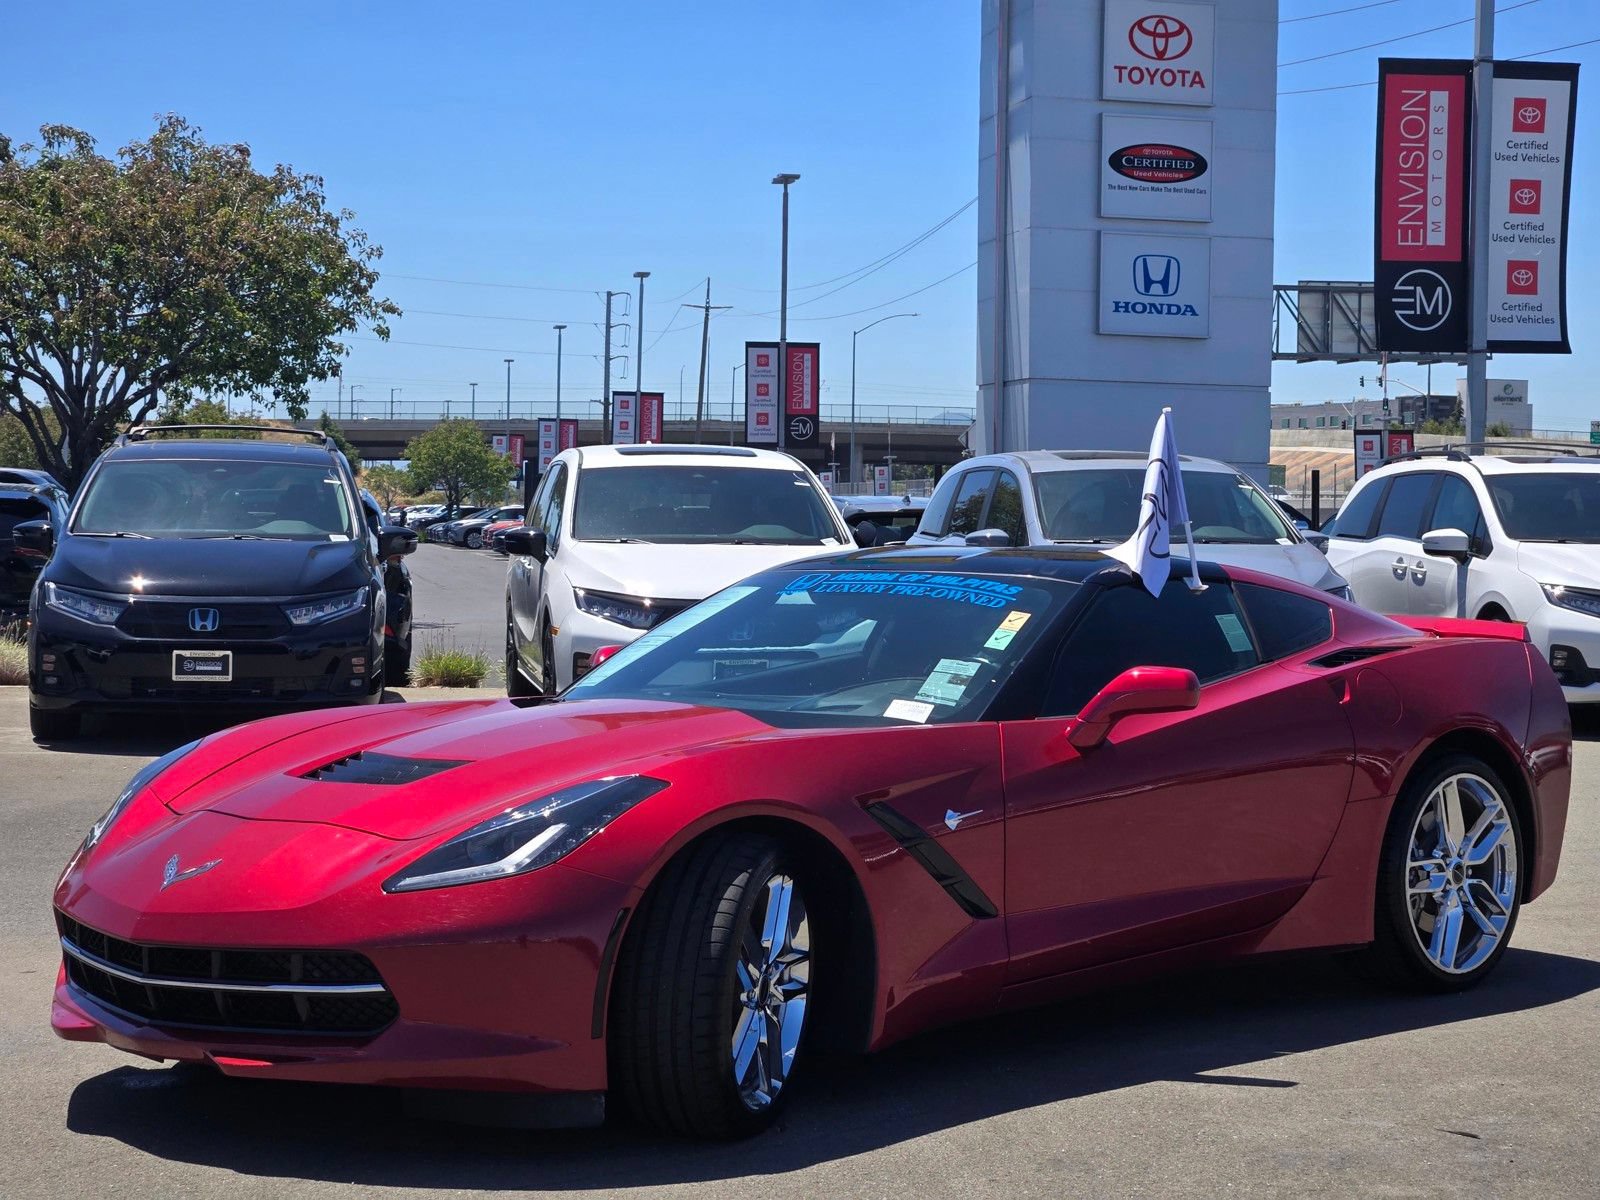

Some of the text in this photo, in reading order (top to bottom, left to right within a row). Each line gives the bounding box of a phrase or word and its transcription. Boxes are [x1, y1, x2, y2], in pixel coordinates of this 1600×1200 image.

[1113, 65, 1205, 88] TOYOTA
[1506, 140, 1548, 150] Certified
[1121, 156, 1195, 170] CERTIFIED
[1494, 152, 1560, 164] Used Vehicles
[1154, 171, 1184, 179] Vehicles
[1398, 89, 1427, 247] ENVISION
[1431, 104, 1446, 233] MOTORS
[1503, 221, 1544, 231] Certified
[1491, 233, 1556, 245] Used Vehicles
[1112, 301, 1199, 317] HONDA
[1501, 302, 1543, 312] Certified
[1490, 314, 1555, 325] Used Vehicles
[792, 352, 803, 410] ENVISION
[829, 573, 1024, 595] HONDA OF MILPITAS
[813, 584, 1007, 608] LUXURY PRE-OWNED
